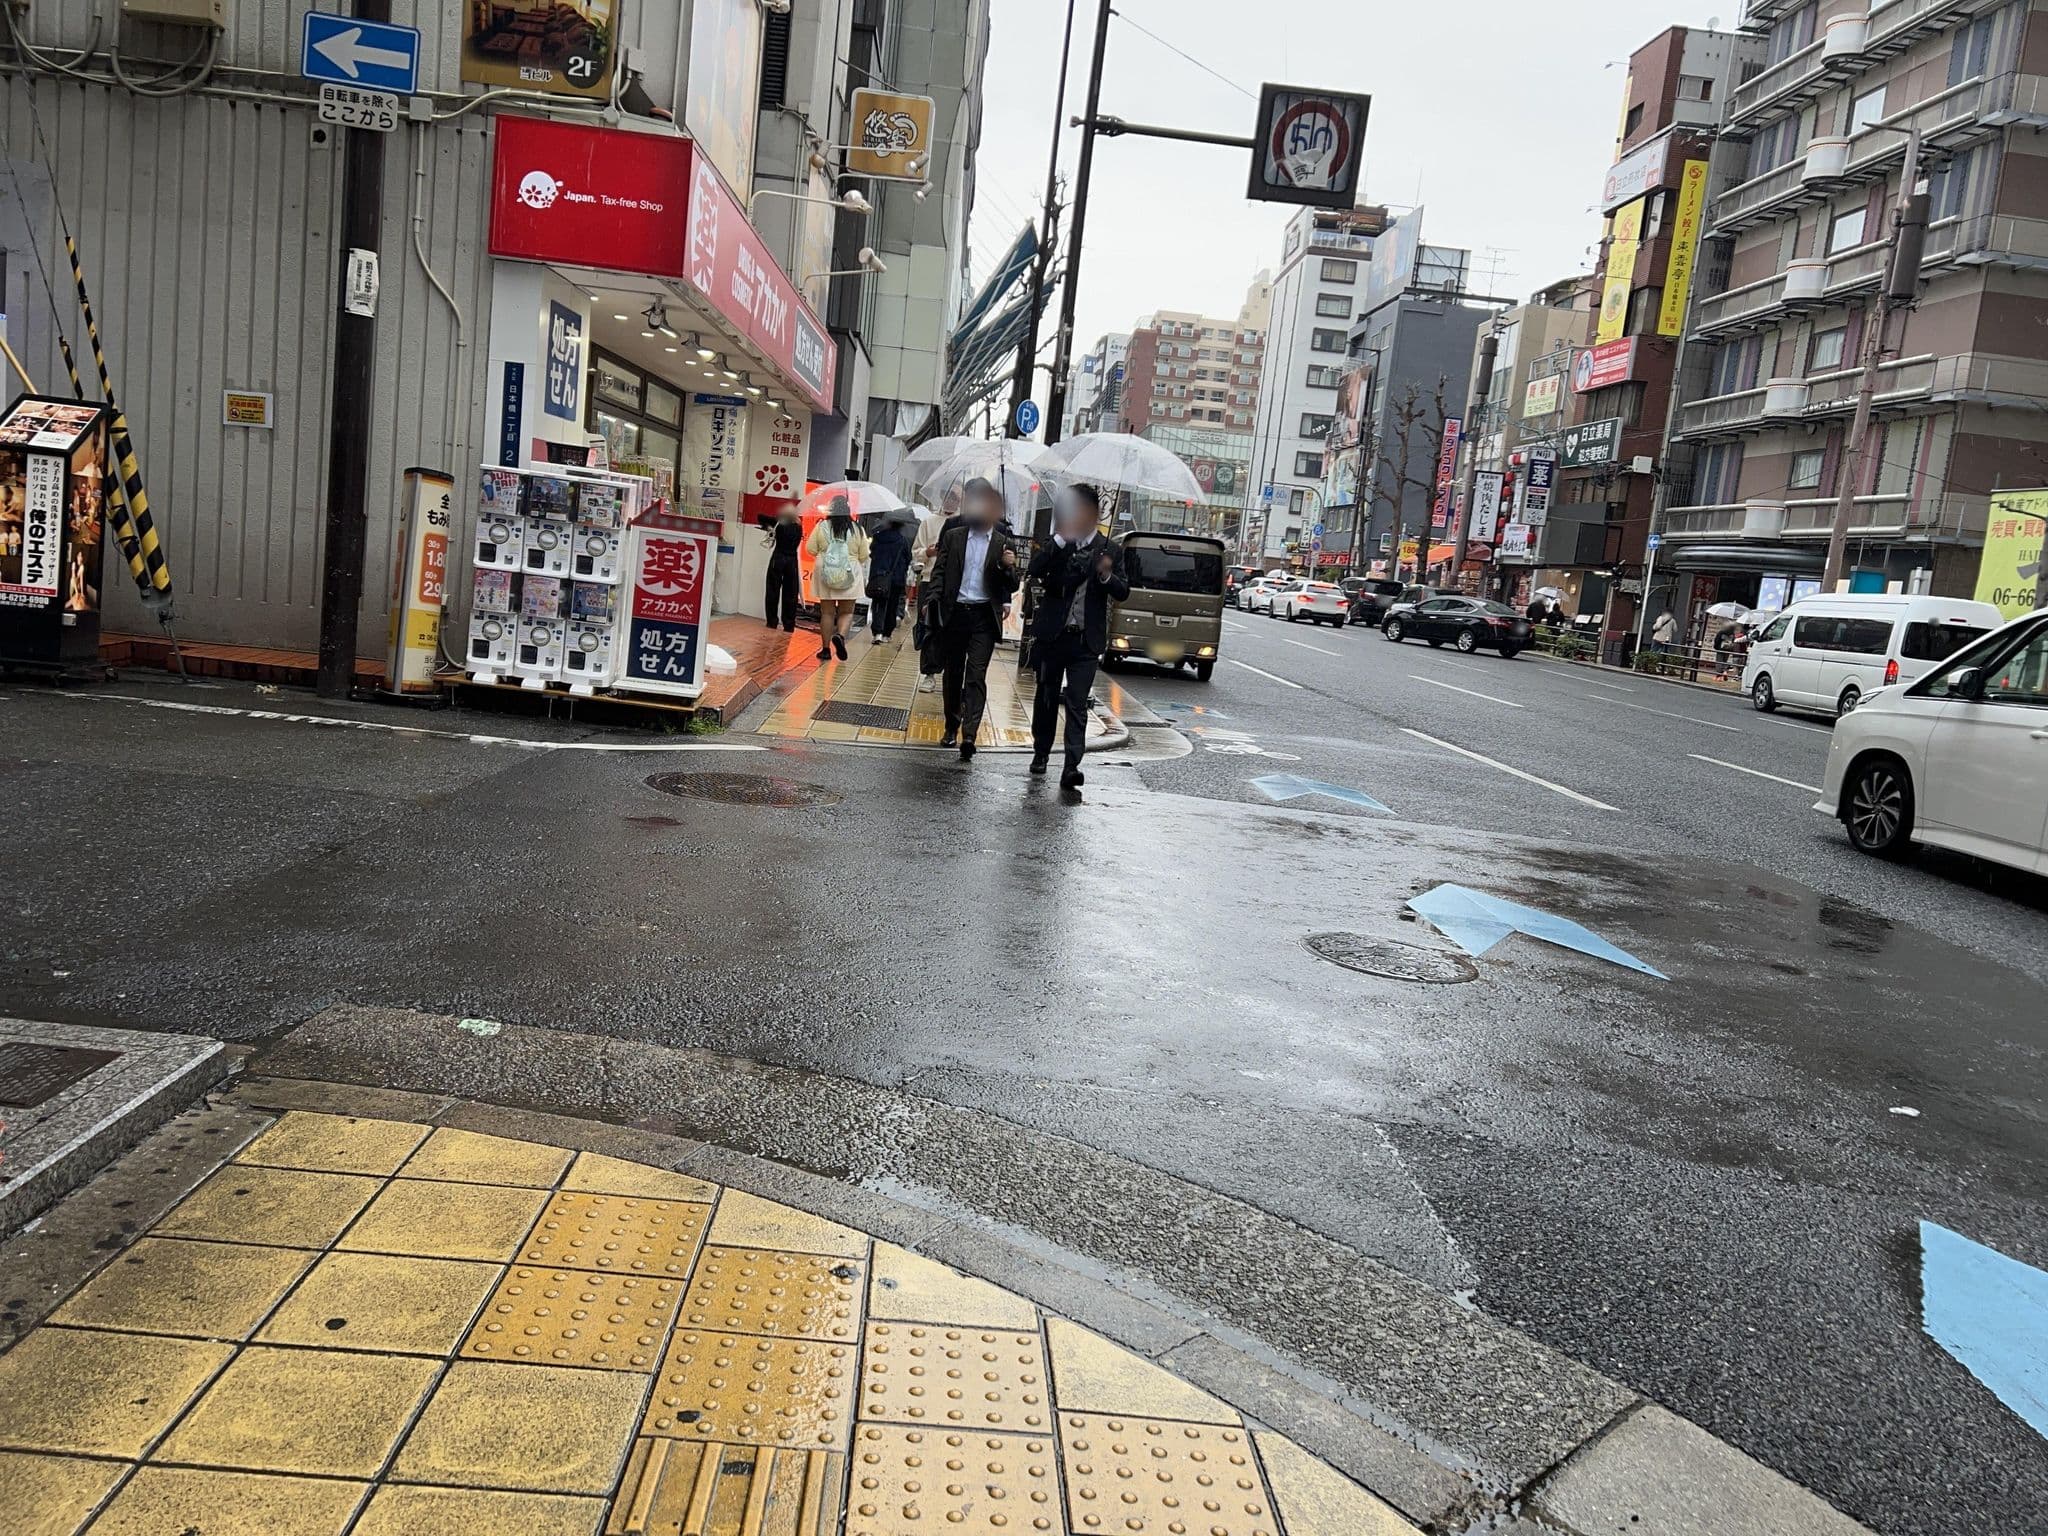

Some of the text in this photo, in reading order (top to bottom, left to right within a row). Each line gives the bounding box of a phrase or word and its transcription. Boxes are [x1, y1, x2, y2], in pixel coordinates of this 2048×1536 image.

[567, 56, 597, 77] 2F
[323, 88, 393, 110] 自転車を除く
[322, 103, 393, 129] ここから
[564, 190, 664, 213] Japan. Tax-free Shop
[1686, 181, 1699, 217] ラーメン
[753, 264, 788, 347] アカカベ
[552, 313, 579, 366] 処方
[551, 364, 576, 409] せん
[506, 384, 518, 442] 日本橋一丁目
[773, 418, 802, 431] くすり
[772, 431, 801, 445] 化粧品
[505, 449, 514, 462] 2
[770, 445, 800, 459] 日用品
[1536, 450, 1551, 459] Niji
[1532, 464, 1550, 486] 薬
[1477, 480, 1494, 537] 焼肉たじま
[27, 509, 47, 584] 俺のエステ
[643, 538, 696, 591] 薬
[641, 597, 693, 615] アカカベ
[640, 628, 689, 655] 処方
[639, 653, 685, 677] せん
